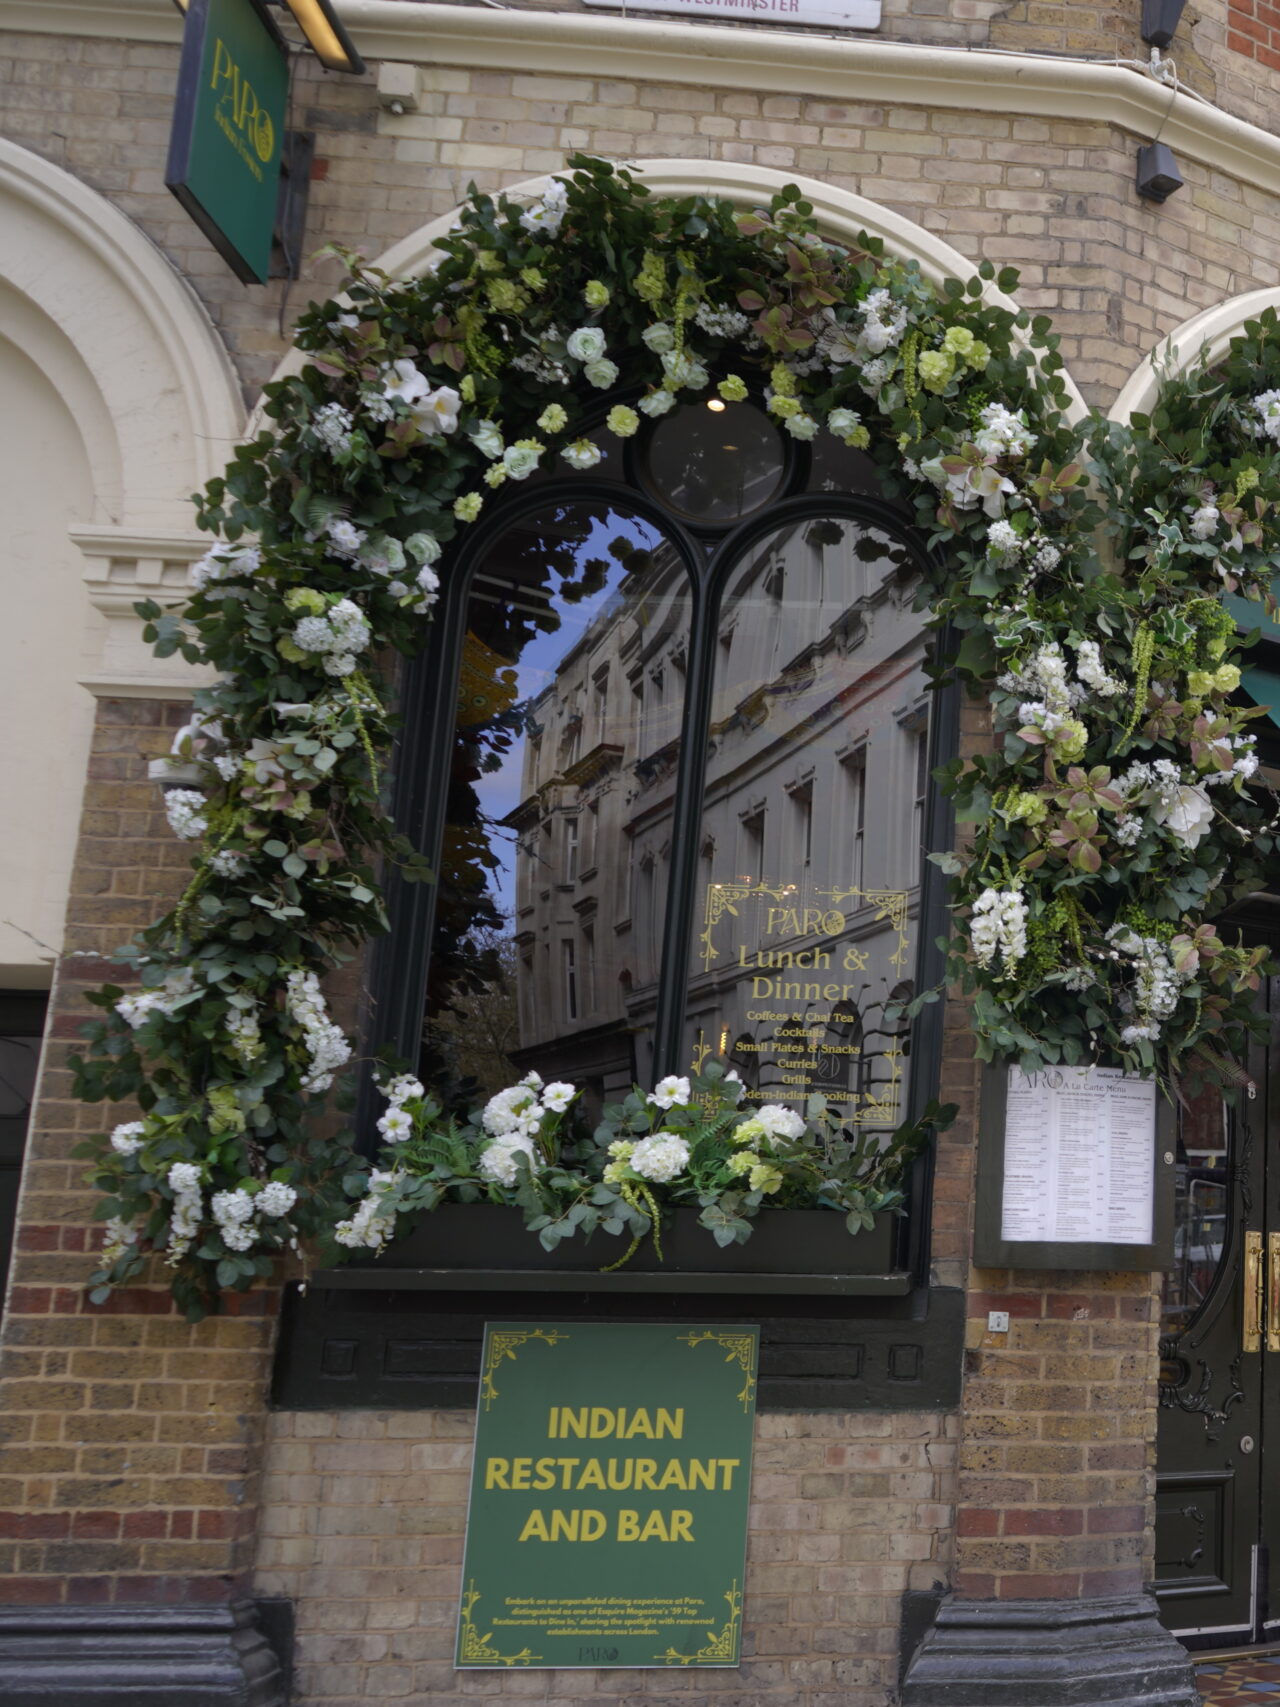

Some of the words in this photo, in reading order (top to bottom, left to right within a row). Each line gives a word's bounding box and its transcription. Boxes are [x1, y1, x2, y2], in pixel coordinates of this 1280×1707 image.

[211, 38, 274, 163] PARO
[766, 908, 846, 936] PARO
[738, 945, 831, 970] Lunch
[843, 948, 869, 971] &
[752, 976, 855, 1001] Dinner
[746, 1010, 789, 1021] Coffees
[791, 1012, 802, 1021] &
[805, 1012, 831, 1022] Chai
[833, 1013, 854, 1023] Tea
[774, 1027, 826, 1038] Cocktails
[735, 1041, 768, 1052] Small
[771, 1042, 804, 1053] Plates
[807, 1044, 818, 1053] &
[820, 1044, 861, 1055] Snacks
[777, 1058, 818, 1069] Curries
[781, 1074, 812, 1085] Grills
[1009, 1069, 1063, 1089] PARO
[1063, 1082, 1070, 1090] A
[1084, 1083, 1105, 1092] Carte
[1107, 1085, 1127, 1093] Menu
[744, 1090, 811, 1100] dern-Indian
[816, 1091, 861, 1104] ooking
[547, 1407, 685, 1439] INDIAN
[484, 1457, 741, 1491] RESTAURANT
[518, 1509, 608, 1542] AND
[616, 1510, 696, 1542] BAR
[505, 1597, 535, 1605] Embark
[608, 1597, 631, 1607] dining
[633, 1598, 673, 1606] experience
[597, 1607, 624, 1616] Esquire
[683, 1607, 698, 1617] Top
[658, 1617, 674, 1625] with
